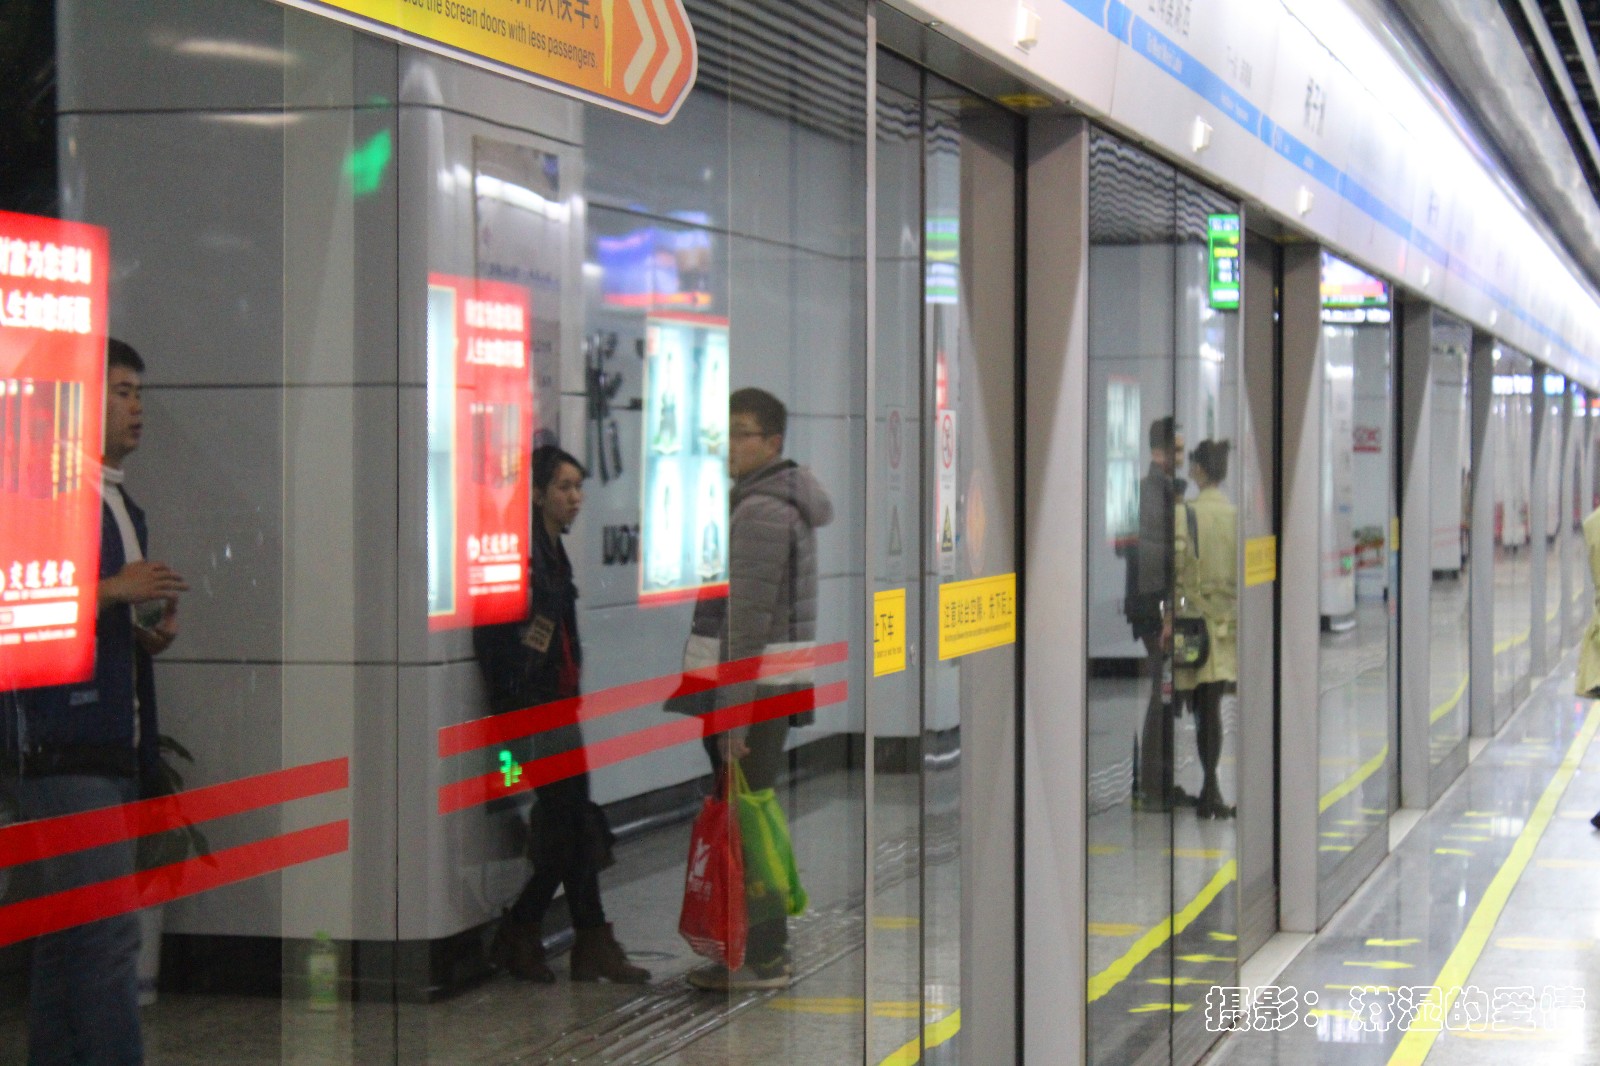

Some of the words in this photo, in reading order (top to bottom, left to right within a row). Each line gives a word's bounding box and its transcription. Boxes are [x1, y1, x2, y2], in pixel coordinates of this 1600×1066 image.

[445, 0, 478, 28] screen
[480, 9, 507, 38] doors
[508, 20, 528, 43] with
[528, 25, 548, 51] less
[548, 35, 598, 70] passengers.
